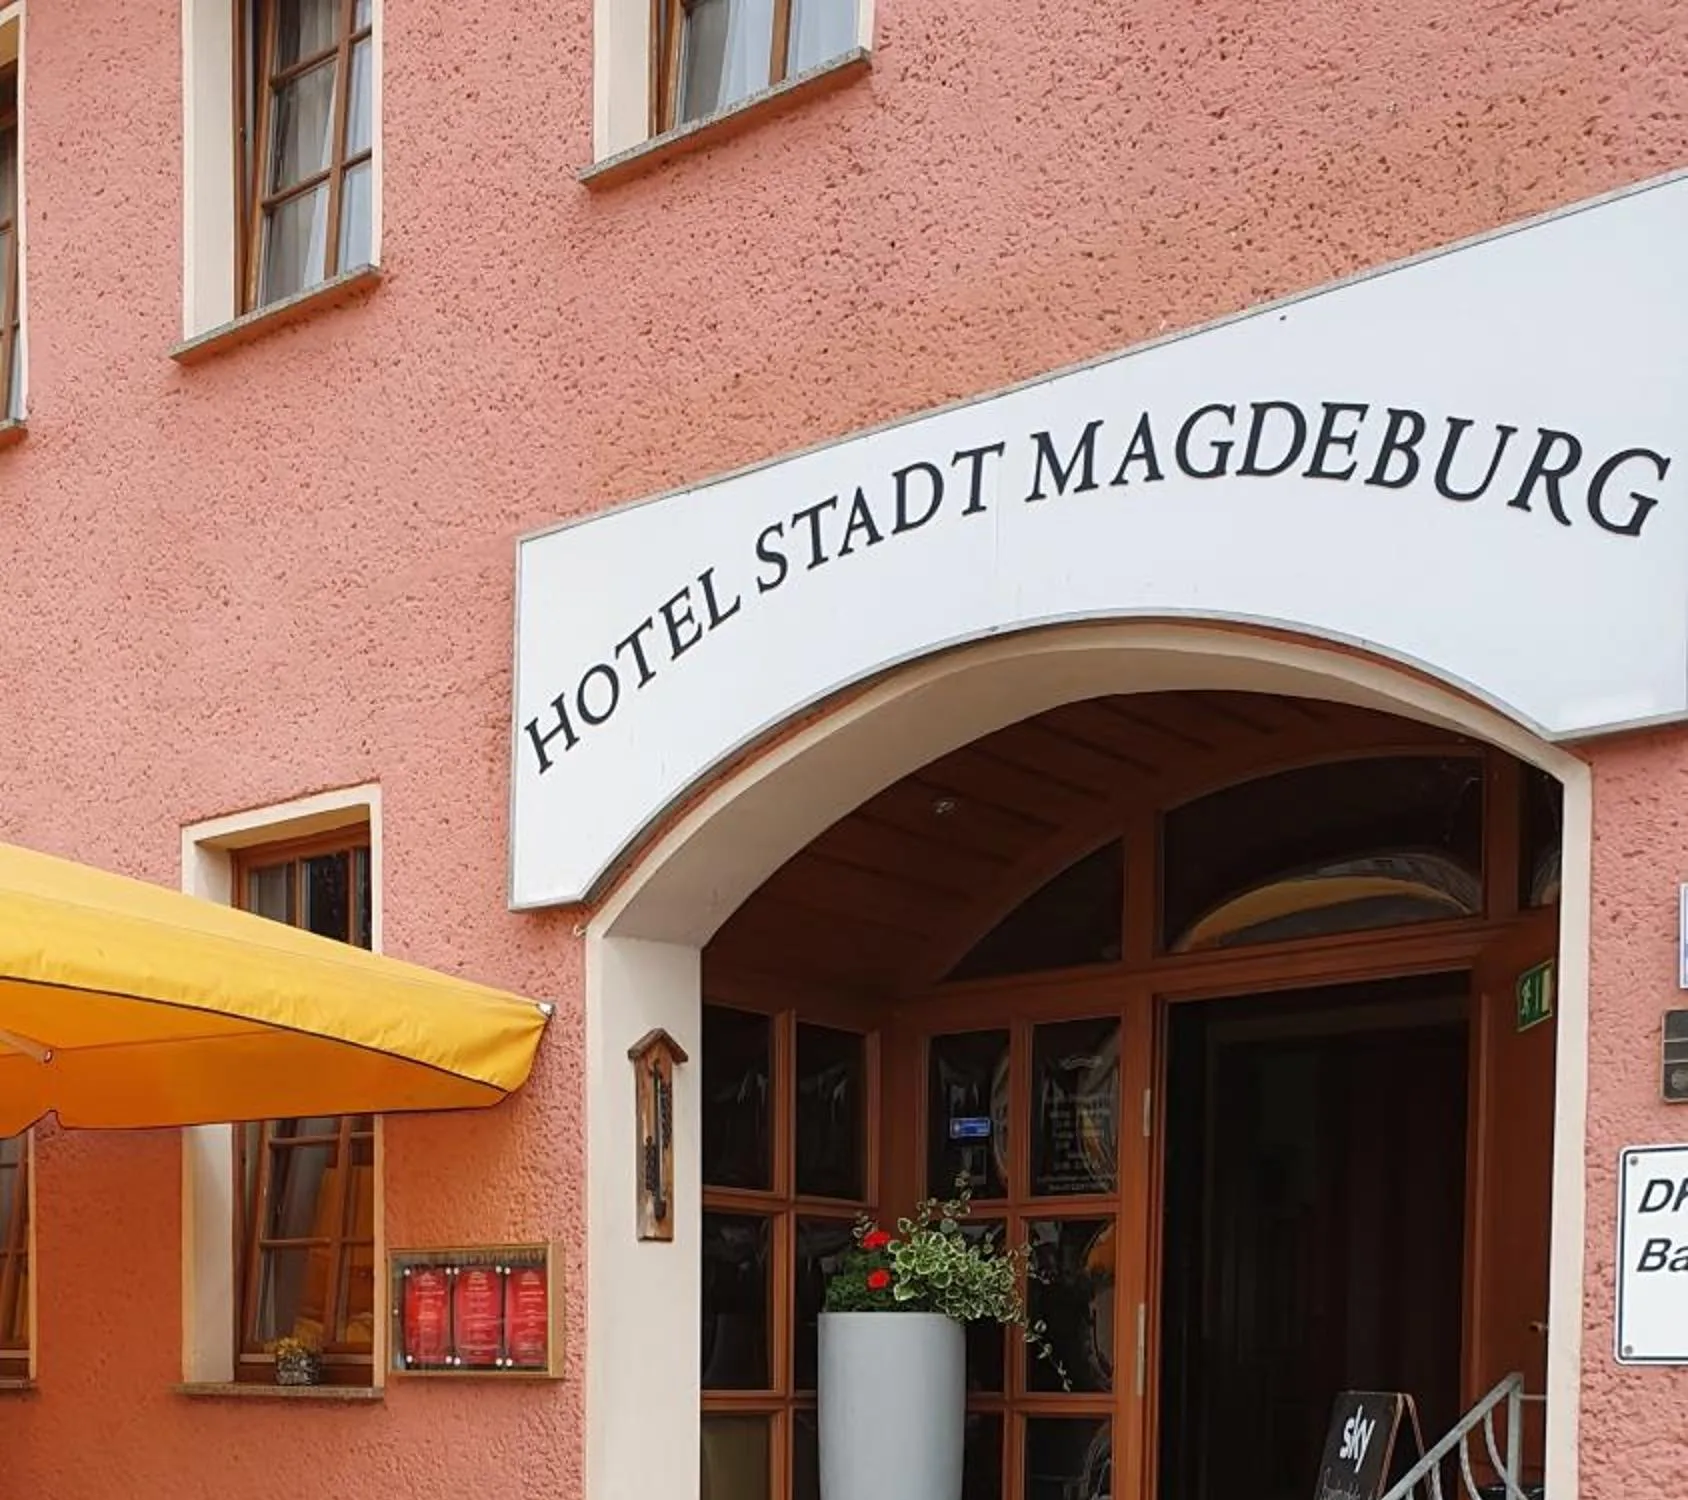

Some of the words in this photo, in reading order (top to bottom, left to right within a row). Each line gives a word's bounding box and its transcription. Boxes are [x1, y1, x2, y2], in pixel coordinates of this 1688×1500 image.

[524, 567, 741, 775] HOTEL
[755, 441, 1006, 594] STADT
[1024, 400, 1672, 537] MAGDEBURG
[1339, 1404, 1376, 1474] sky
